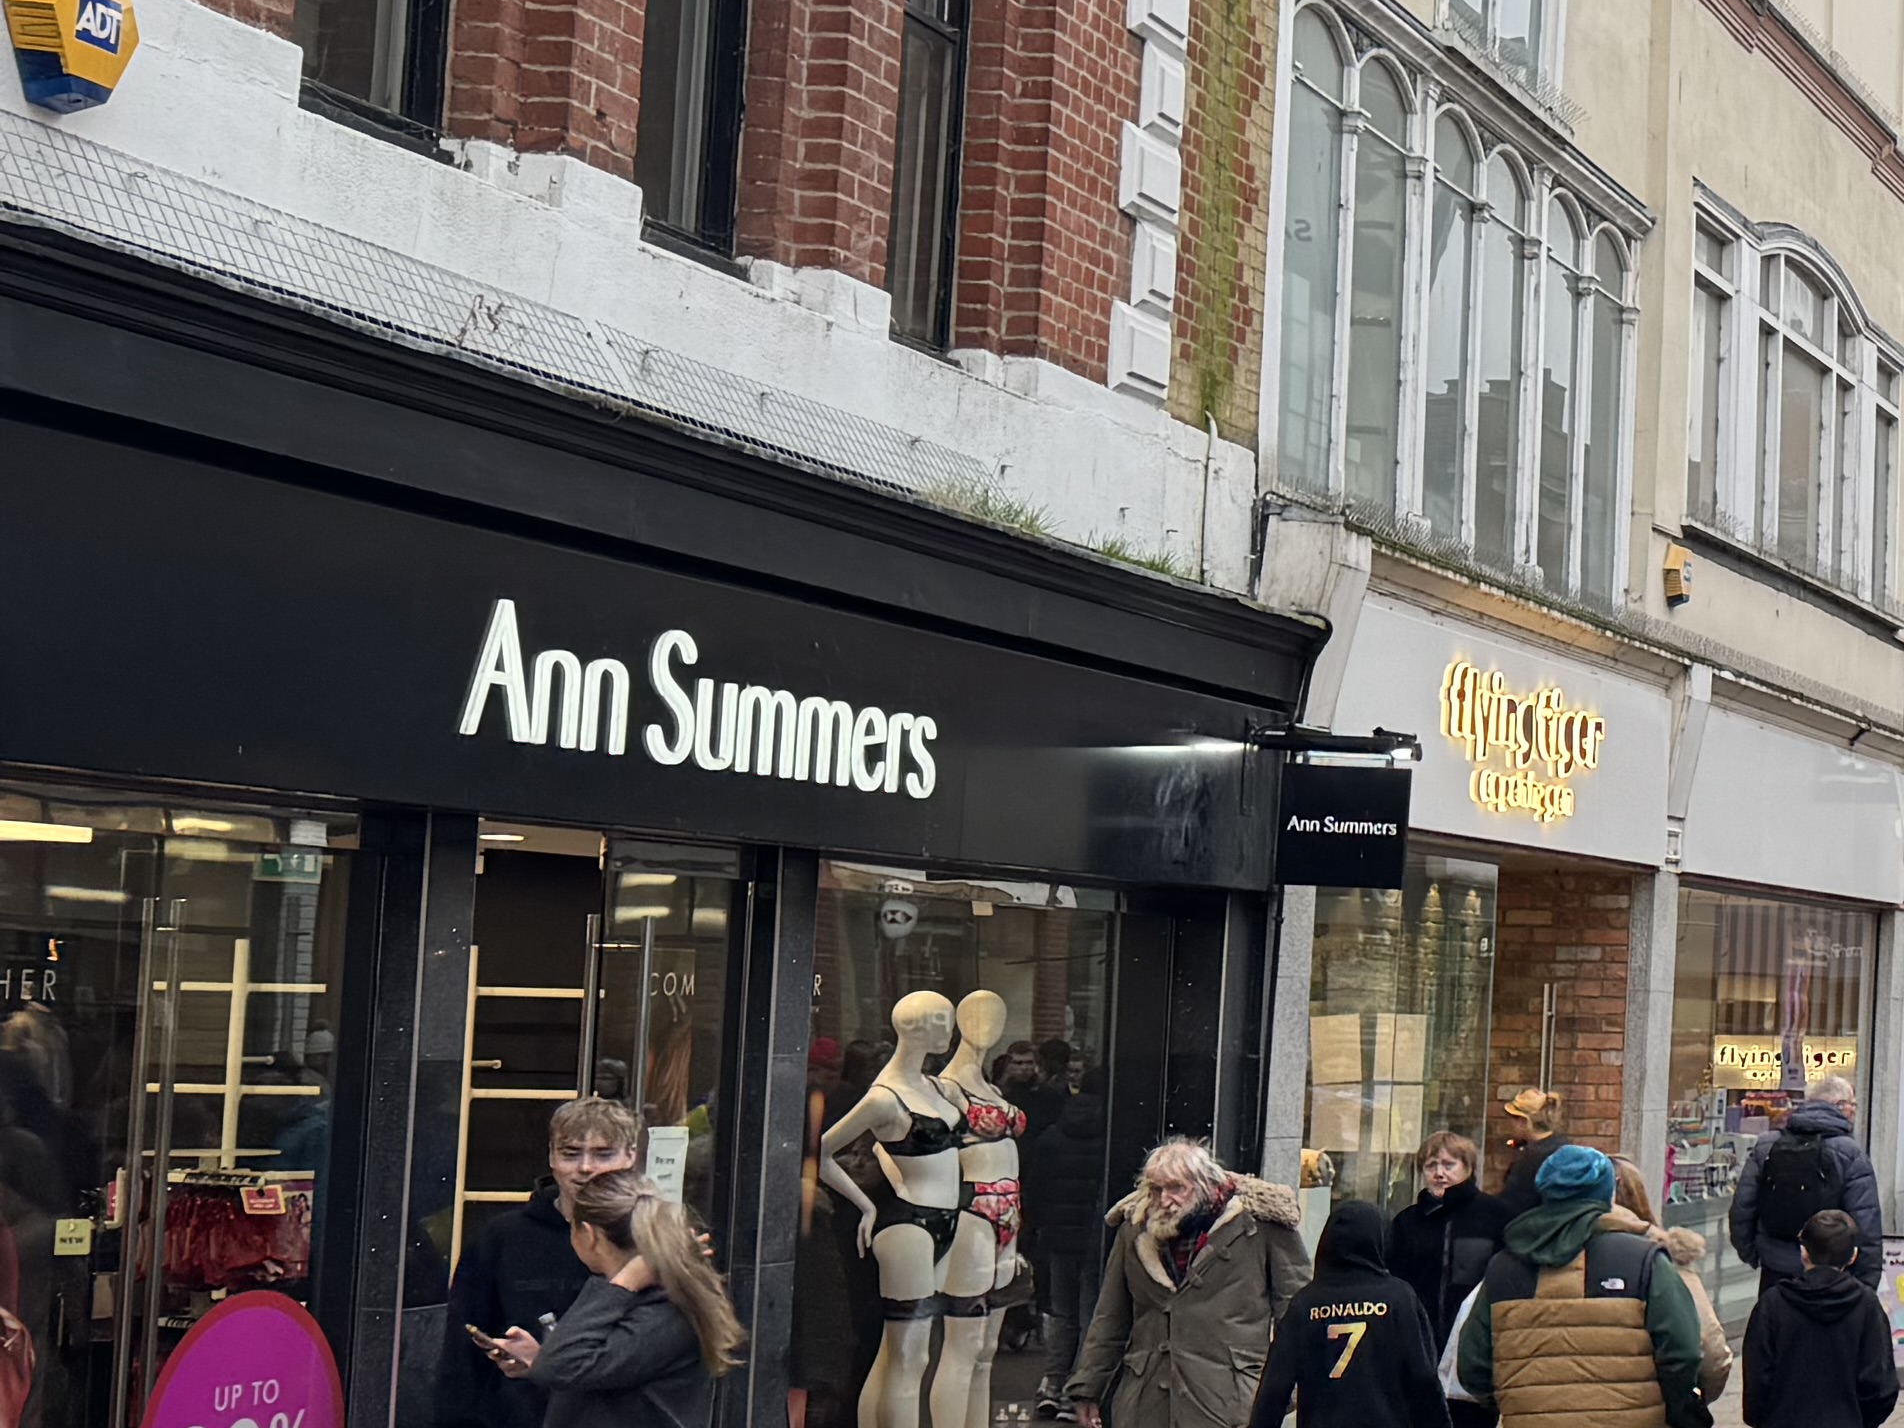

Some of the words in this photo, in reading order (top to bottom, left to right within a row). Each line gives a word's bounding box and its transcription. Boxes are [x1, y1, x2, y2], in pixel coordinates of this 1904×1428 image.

[76, 0, 123, 46] ADT
[459, 598, 631, 756] Ann
[645, 628, 938, 800] Summers
[1286, 814, 1322, 835] Ann
[1323, 816, 1399, 837] Summers
[1801, 1045, 1855, 1069] iger
[1309, 1302, 1388, 1321] RONALDO
[1327, 1321, 1368, 1380] 7
[214, 1383, 242, 1413] UP
[252, 1379, 280, 1404] TO
